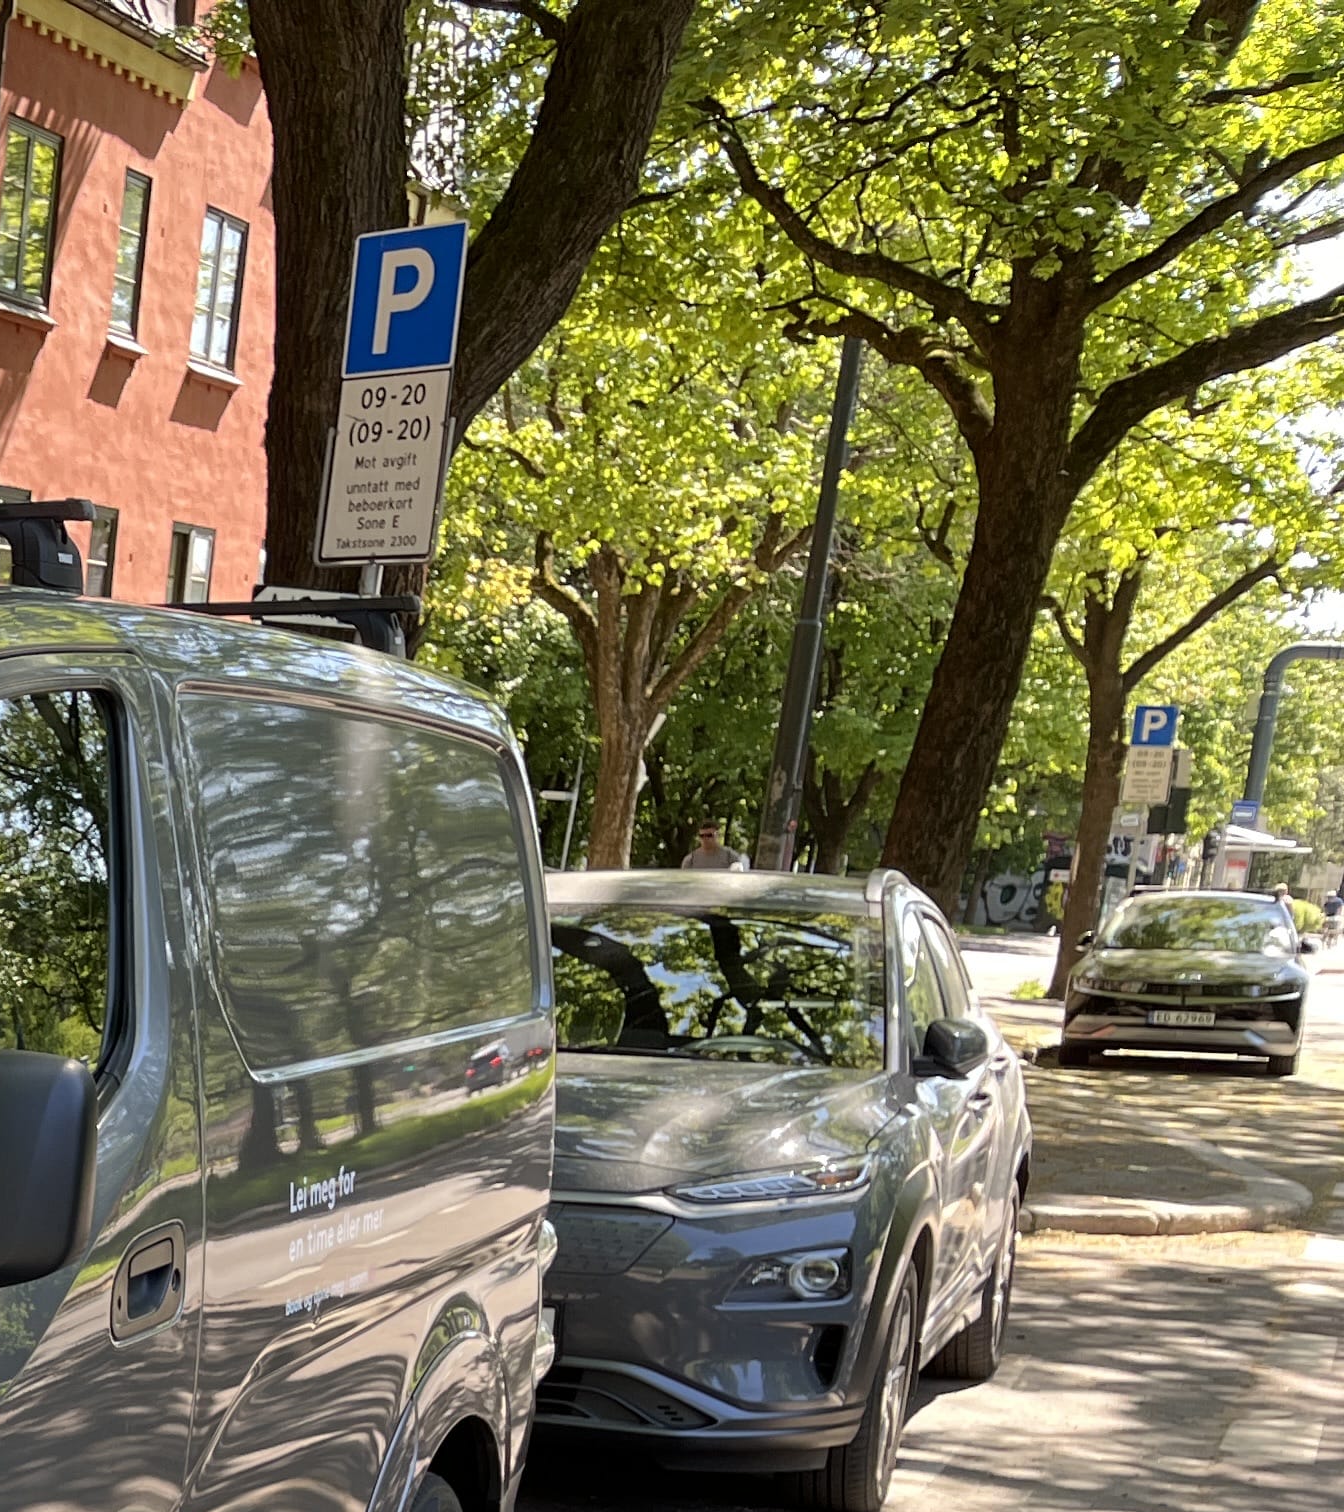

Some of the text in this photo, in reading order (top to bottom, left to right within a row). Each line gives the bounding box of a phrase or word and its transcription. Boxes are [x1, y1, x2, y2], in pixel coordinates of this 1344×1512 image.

[371, 247, 435, 355] P
[361, 383, 426, 410] 09-20
[348, 415, 431, 447] (09-20)
[354, 452, 417, 471] Mot avgift
[346, 477, 420, 495] unntatt med
[347, 497, 413, 513] beboerkort
[356, 515, 400, 530] Sone E
[336, 534, 417, 550] Takstsone 2300
[1142, 709, 1167, 742] P
[289, 1165, 356, 1213] Lei meg for
[288, 1208, 385, 1262] en time eller mer
